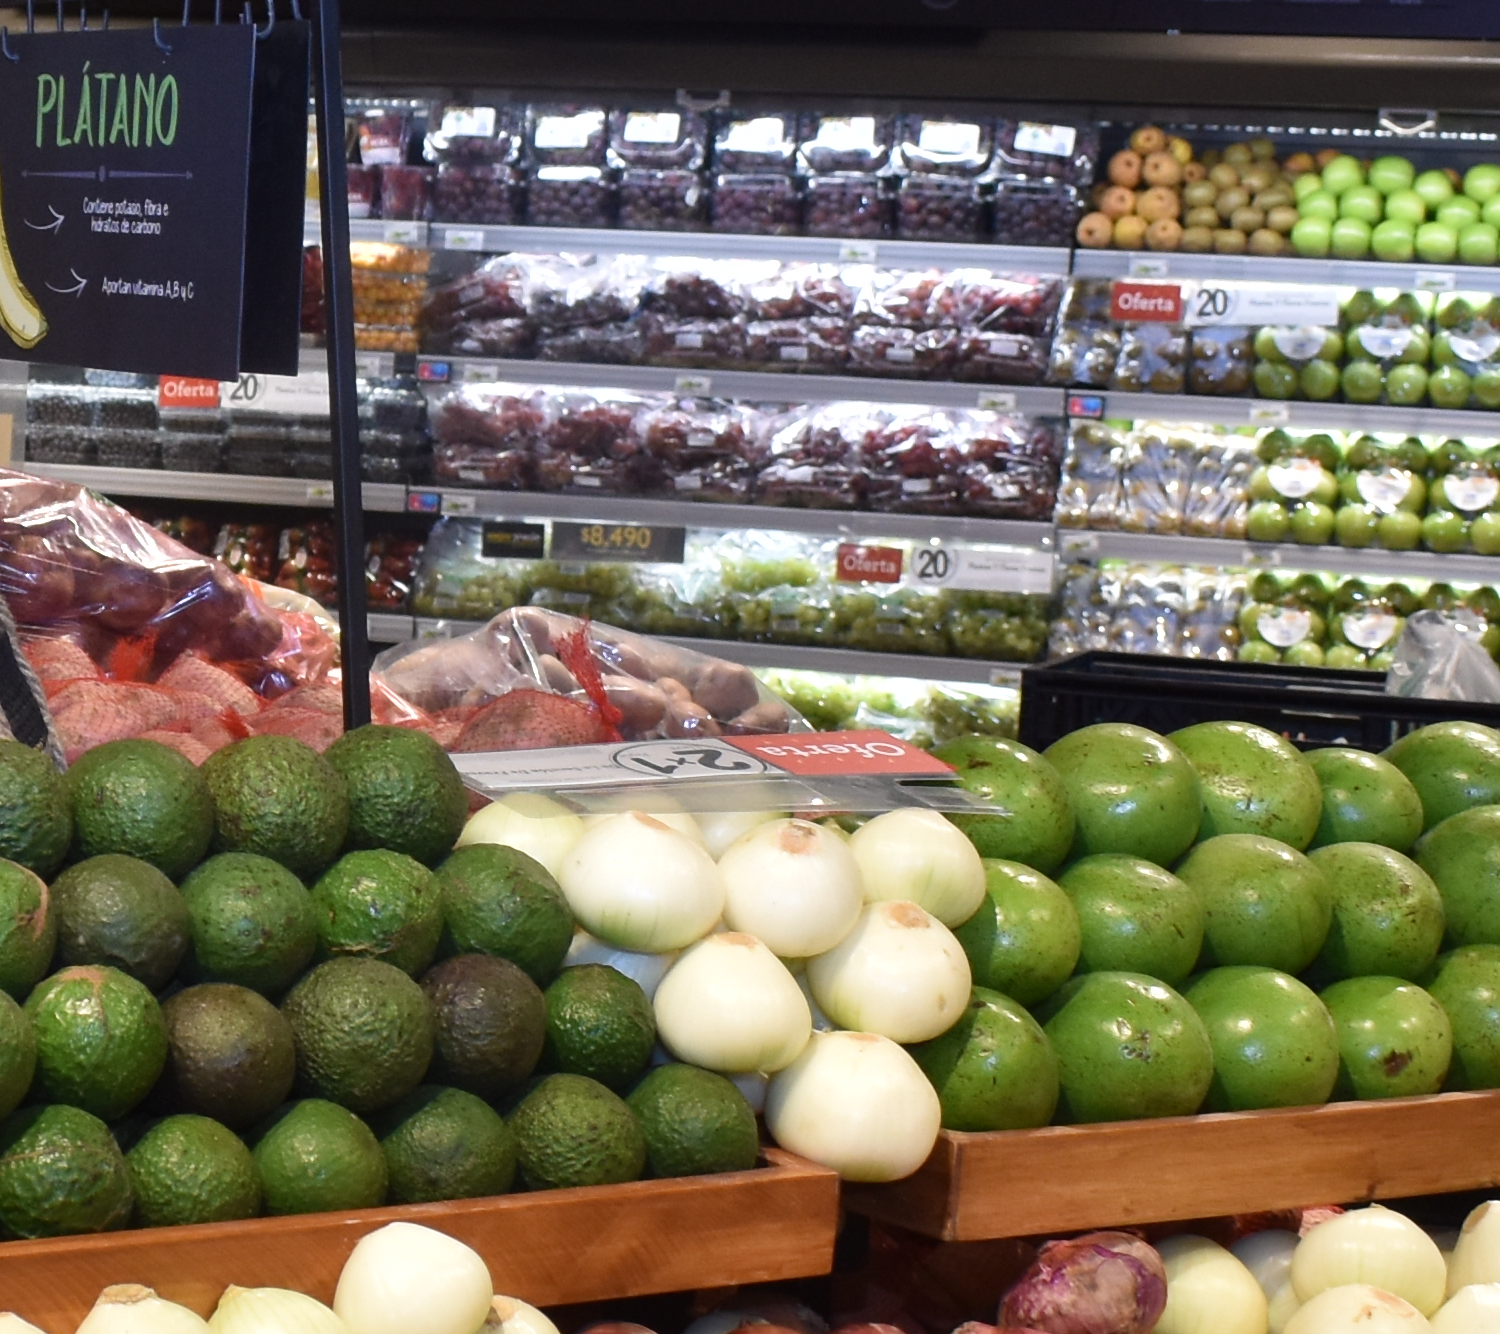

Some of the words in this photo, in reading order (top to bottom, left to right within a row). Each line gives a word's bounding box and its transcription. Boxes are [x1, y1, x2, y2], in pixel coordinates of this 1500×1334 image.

[35, 60, 179, 149] PLÁTANO
[1118, 292, 1176, 315] Oferta
[1196, 288, 1228, 317] 20
[757, 741, 907, 760] Oferta
